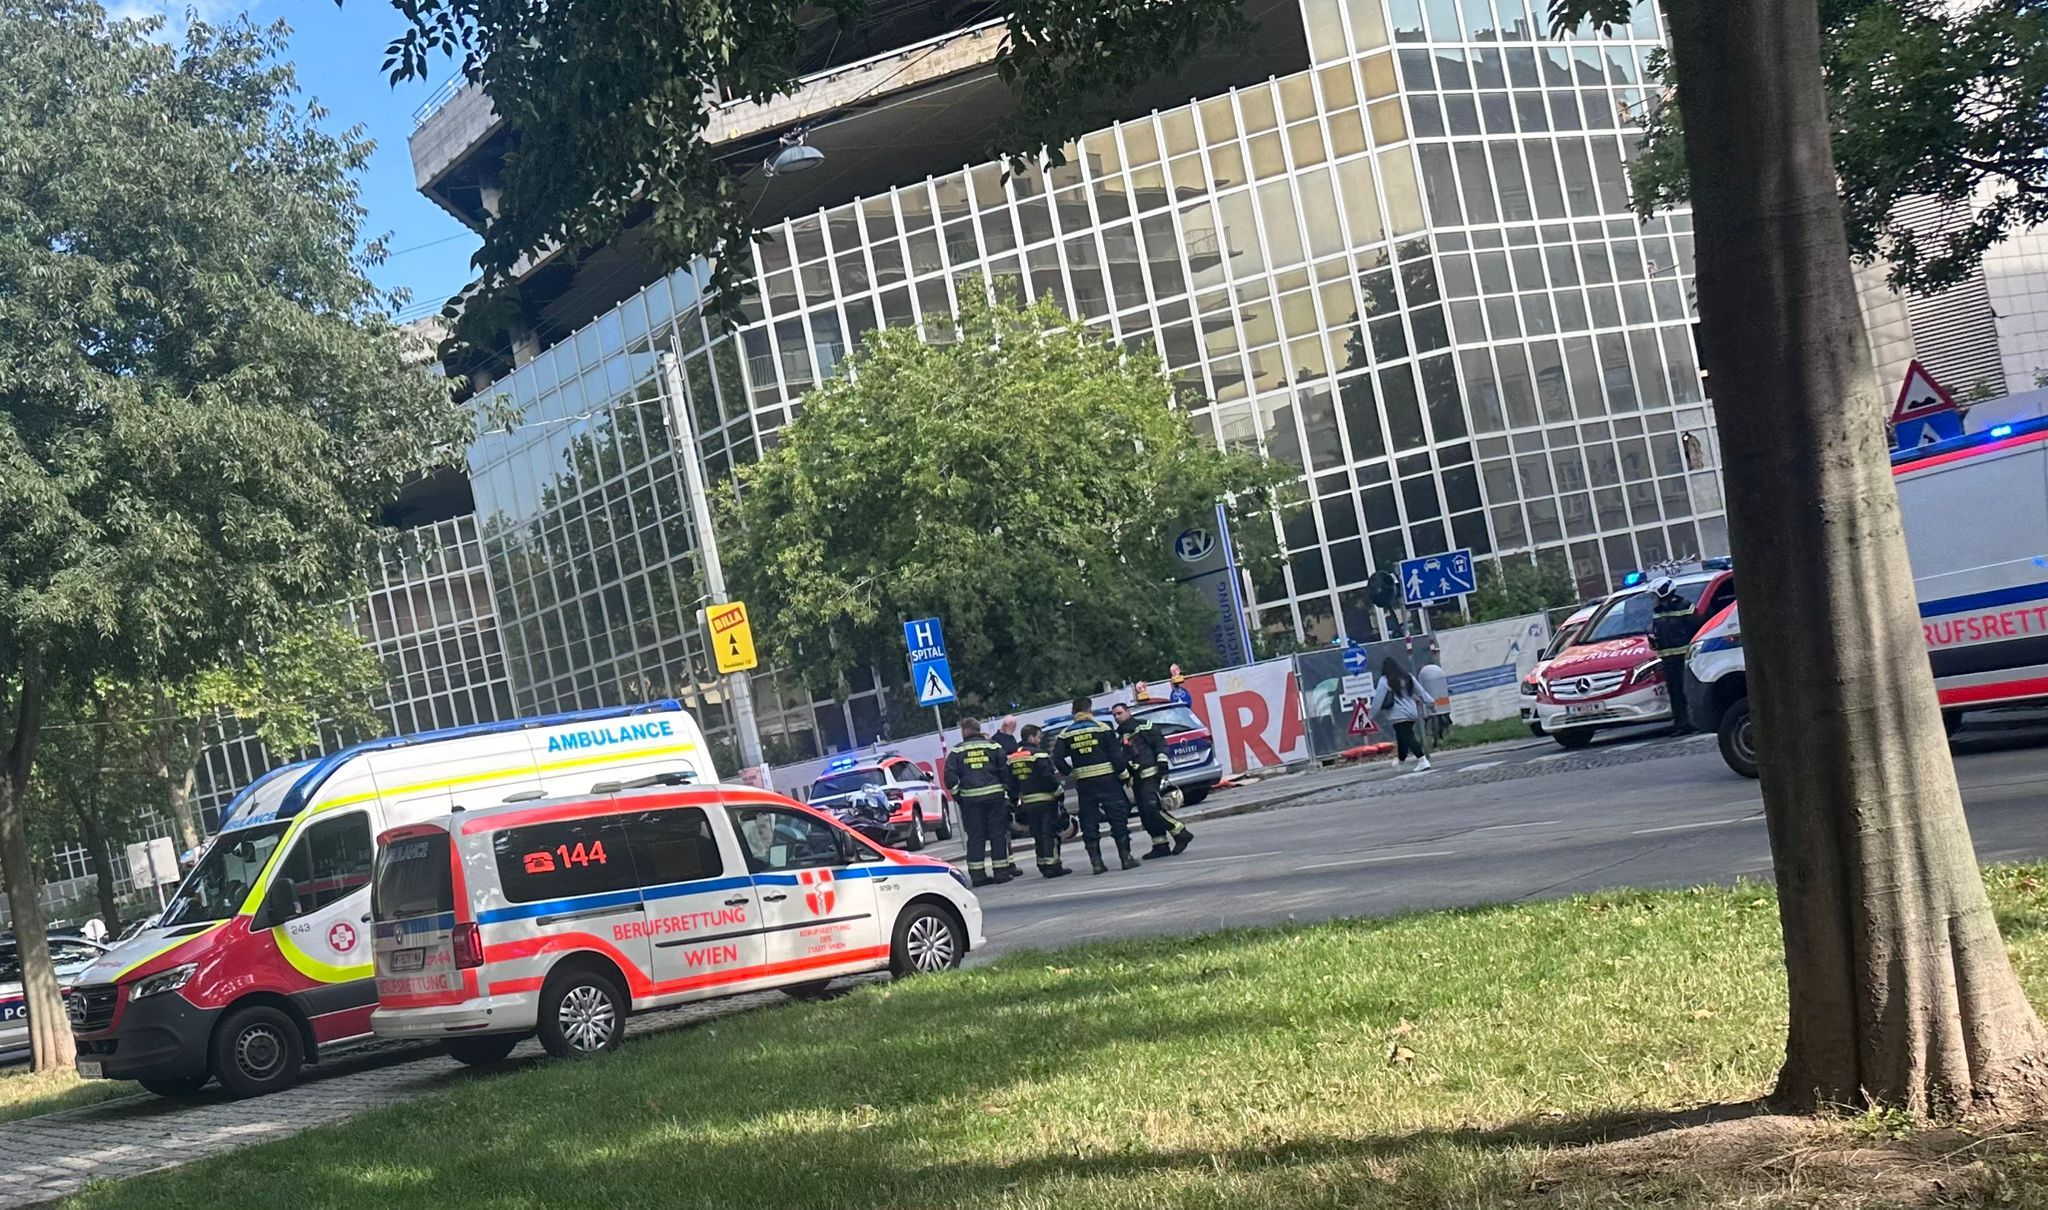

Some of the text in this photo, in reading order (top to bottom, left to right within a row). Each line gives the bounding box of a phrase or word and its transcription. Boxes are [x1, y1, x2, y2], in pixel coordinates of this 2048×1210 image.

[712, 610, 743, 632] BILLA
[915, 623, 933, 648] H
[912, 646, 944, 662] SPITAL
[1171, 671, 1306, 775] TRA
[548, 721, 674, 752] AMBULANCE
[1173, 745, 1198, 756] POLIZEI
[557, 840, 607, 868] 144
[291, 923, 311, 935] 243
[612, 907, 745, 941] BERUFSRETTUNG
[684, 944, 738, 967] WIEN
